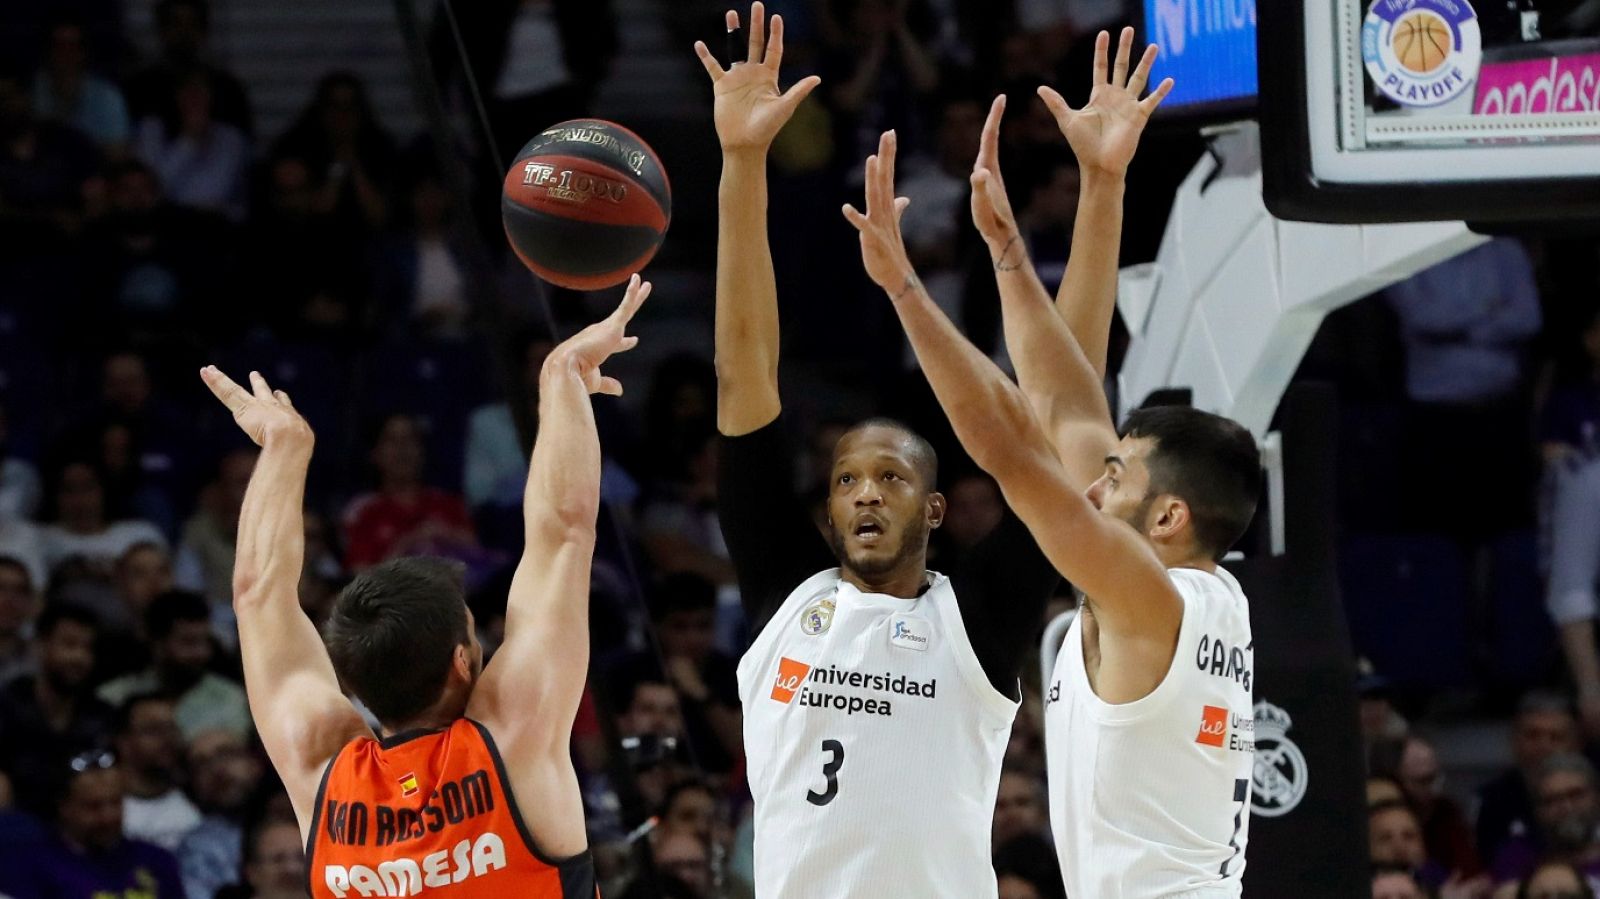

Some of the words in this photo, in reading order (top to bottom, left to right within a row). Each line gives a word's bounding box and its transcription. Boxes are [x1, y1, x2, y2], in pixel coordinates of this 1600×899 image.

[1384, 66, 1464, 100] PLAYOFF
[523, 162, 627, 203] TF-1000
[799, 687, 892, 716] Europea
[809, 664, 936, 699] niversidad
[806, 739, 845, 806] 3
[327, 800, 368, 847] VAN
[324, 832, 507, 898] PAMESA
